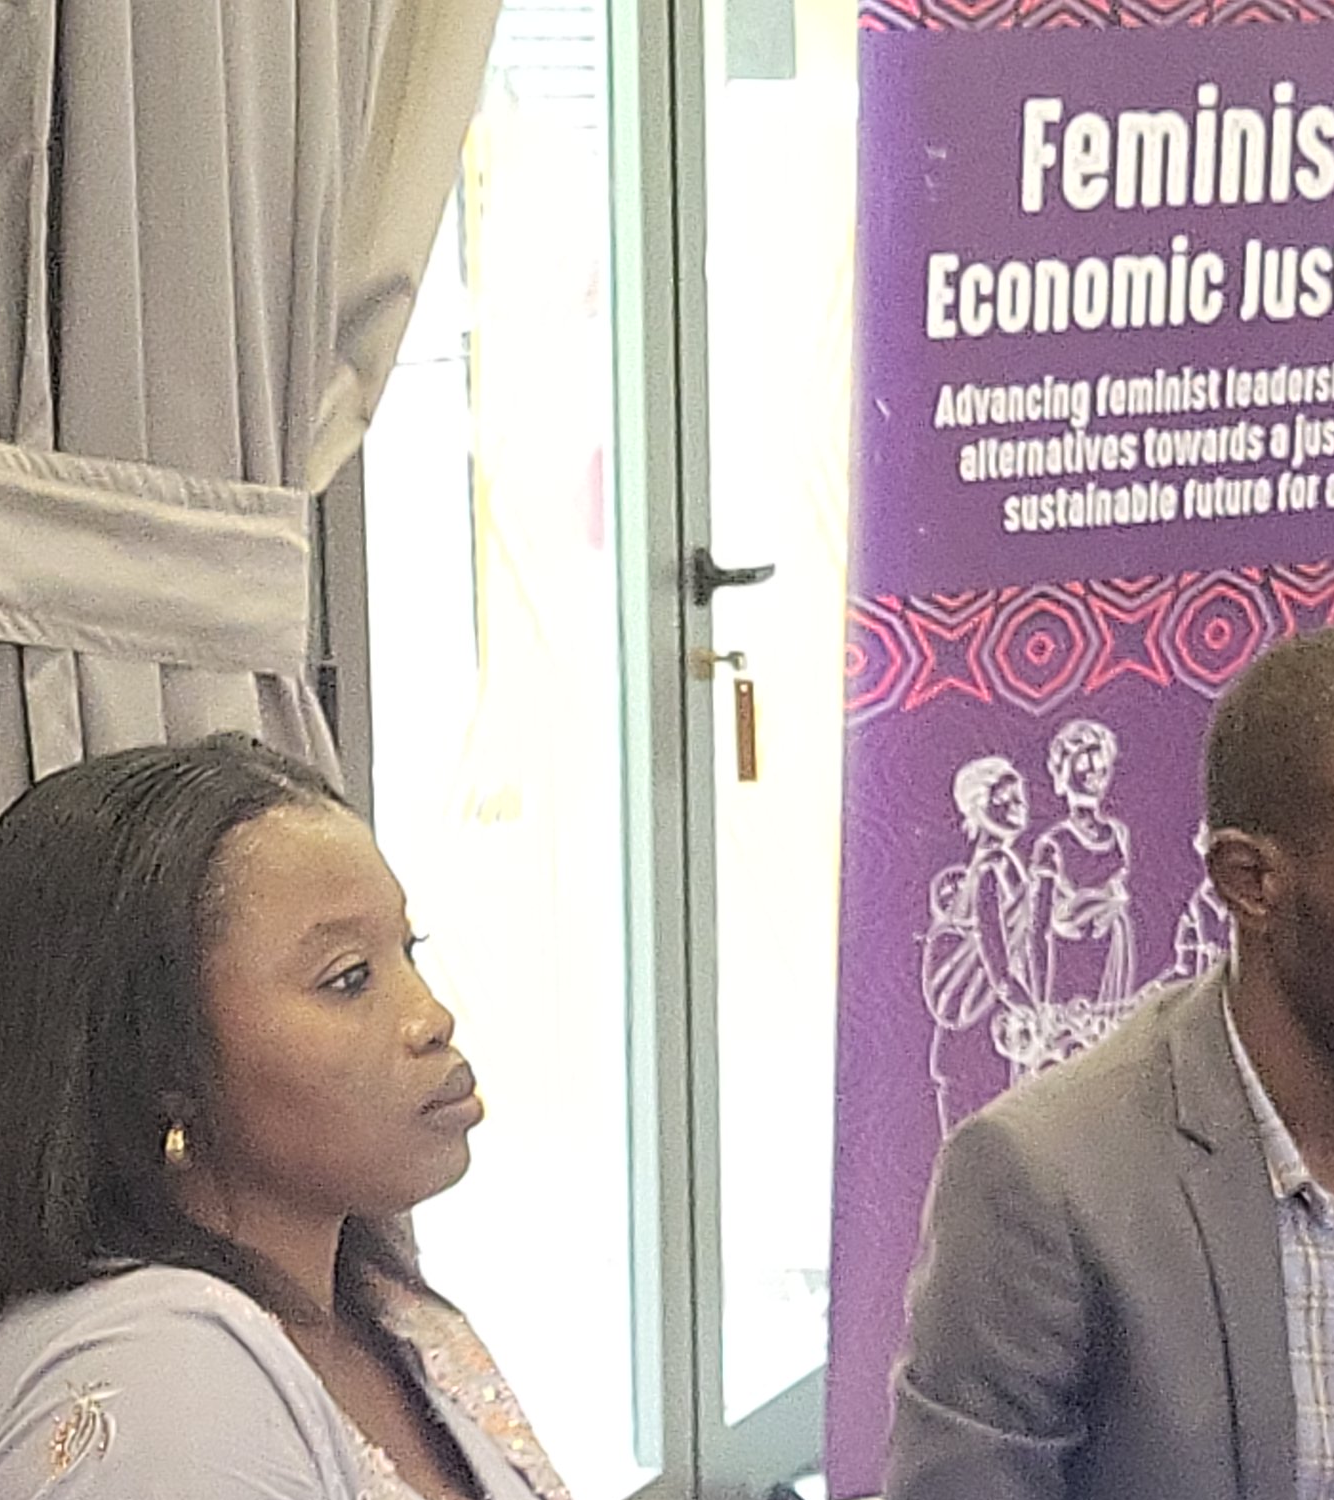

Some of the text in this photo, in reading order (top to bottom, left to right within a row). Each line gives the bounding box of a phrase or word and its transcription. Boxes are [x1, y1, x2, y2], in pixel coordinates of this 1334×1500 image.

[926, 235, 1224, 339] Economic
[934, 376, 1091, 428] Advancing
[1096, 366, 1221, 417] feminist
[959, 428, 1138, 482] alternatives
[1143, 419, 1263, 470] towards
[1269, 430, 1287, 459] a
[1003, 481, 1177, 534] sustainable
[1183, 472, 1271, 521] future
[1276, 472, 1320, 512] for
